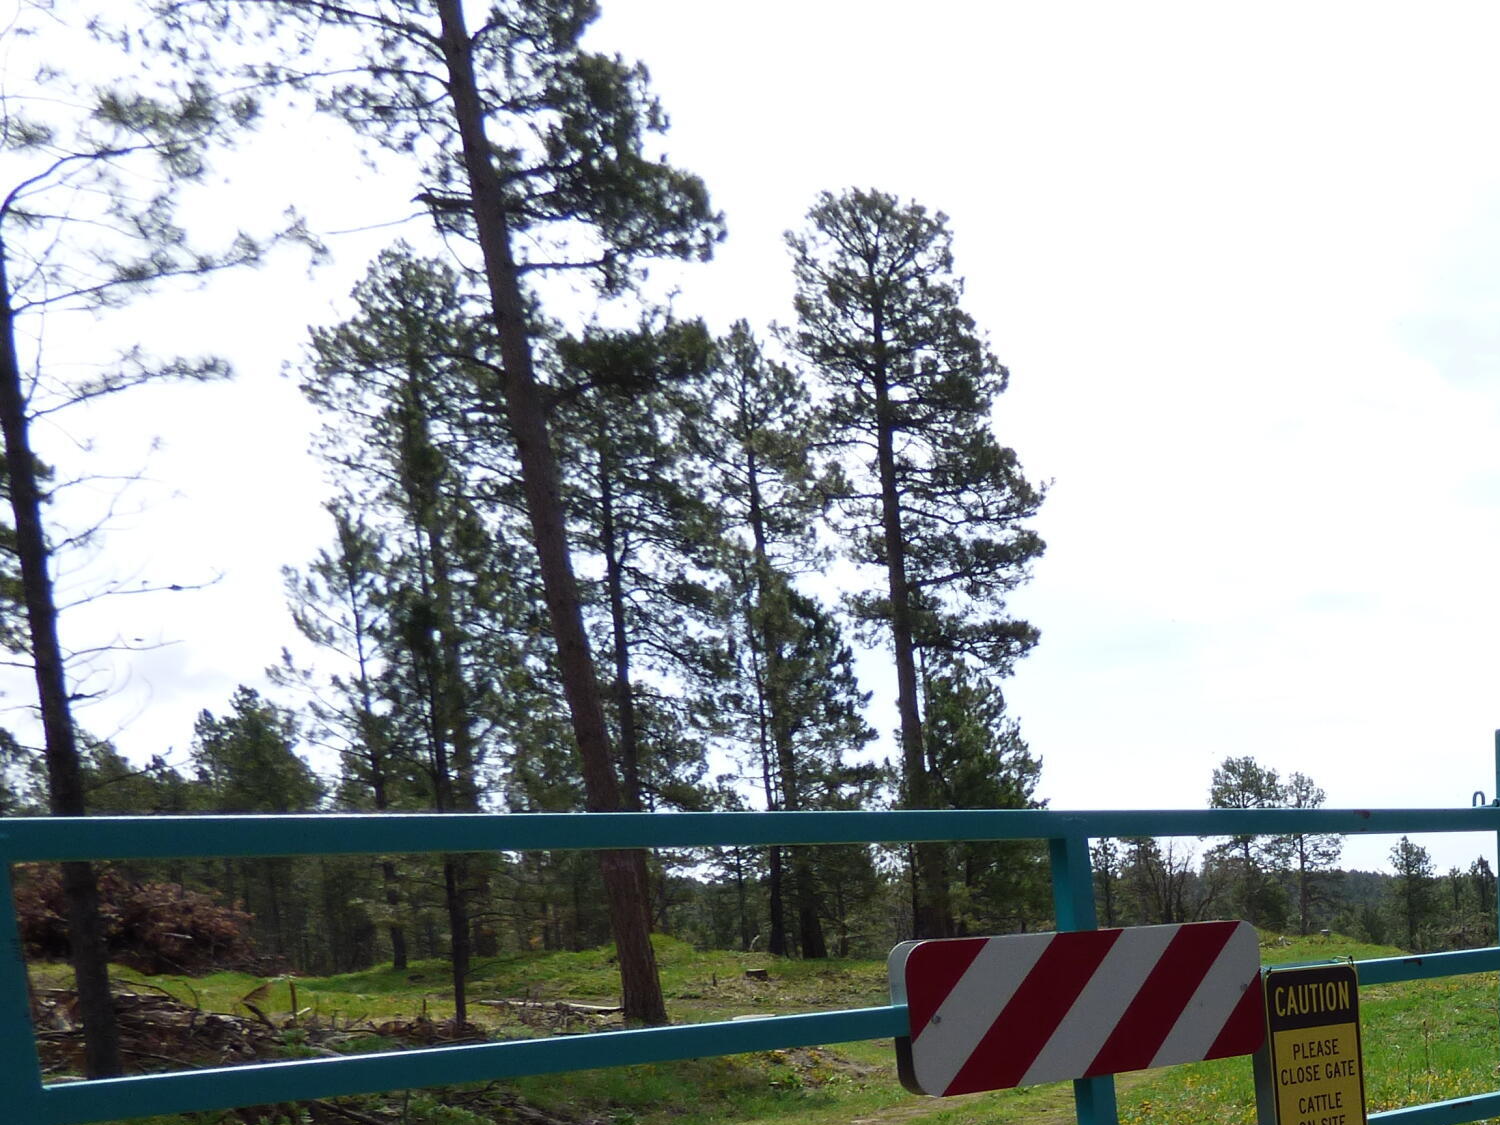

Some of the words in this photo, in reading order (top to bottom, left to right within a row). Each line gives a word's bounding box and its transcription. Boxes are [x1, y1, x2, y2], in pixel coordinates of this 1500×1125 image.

[1275, 981, 1349, 1016] CAUTION
[1293, 1039, 1339, 1060] PLEASE
[1281, 1065, 1320, 1085] CLOSE
[1326, 1060, 1355, 1078] GATE
[1299, 1092, 1342, 1113] CATTLE
